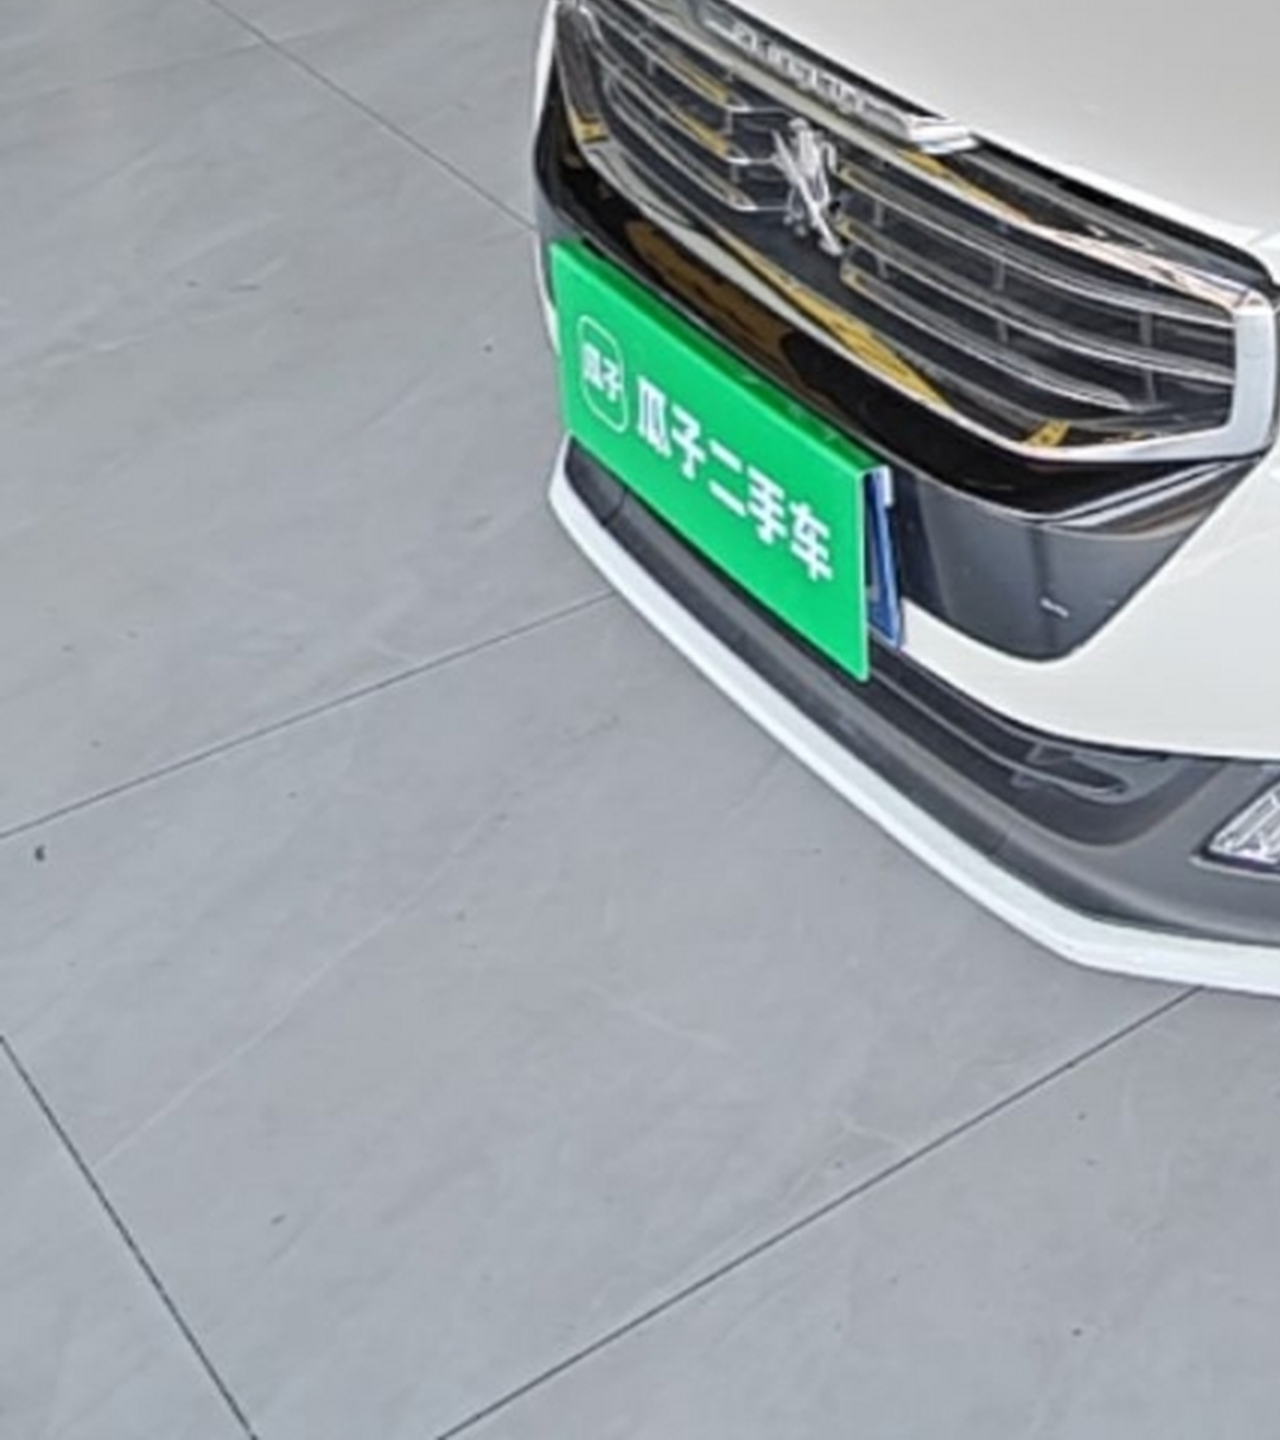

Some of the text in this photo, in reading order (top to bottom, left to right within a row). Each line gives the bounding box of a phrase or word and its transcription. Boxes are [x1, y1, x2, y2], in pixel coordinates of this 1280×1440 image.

[636, 374, 834, 582] 瓜子二手车
